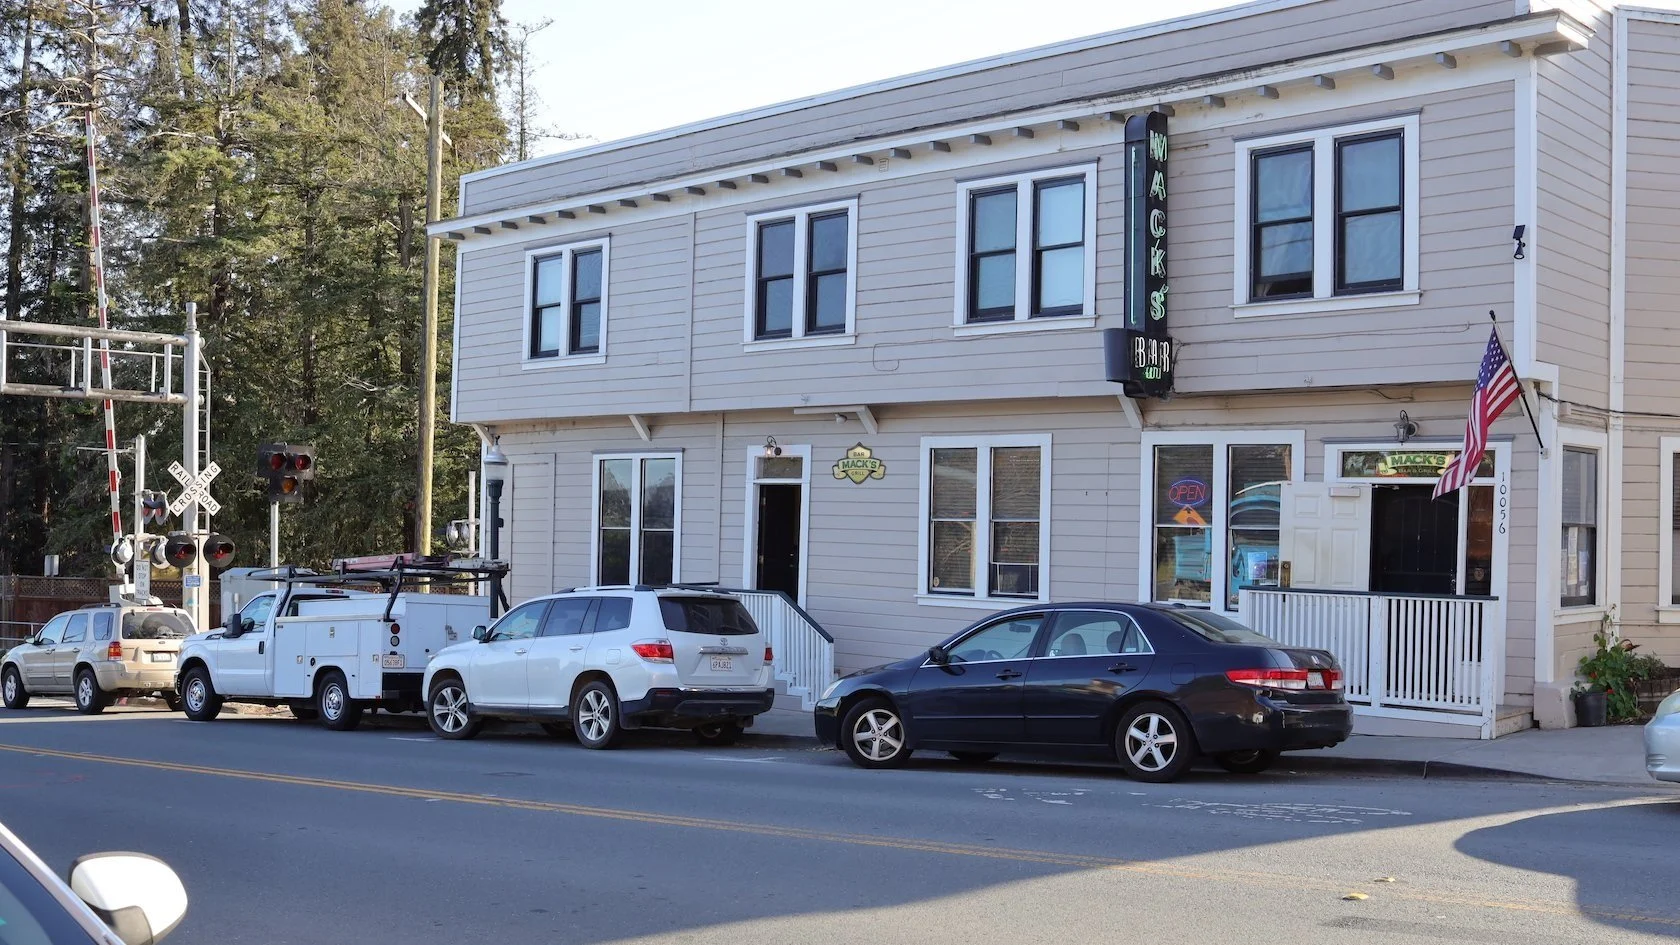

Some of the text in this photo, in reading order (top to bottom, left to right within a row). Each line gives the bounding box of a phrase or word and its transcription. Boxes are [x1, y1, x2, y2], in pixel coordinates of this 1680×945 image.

[1134, 336, 1170, 373] BAR
[841, 459, 877, 469] MACK'S
[1390, 454, 1446, 466] MACK'S
[172, 465, 218, 513] CROSSING
[1168, 484, 1206, 501] OPEN
[1499, 471, 1507, 534] 10056
